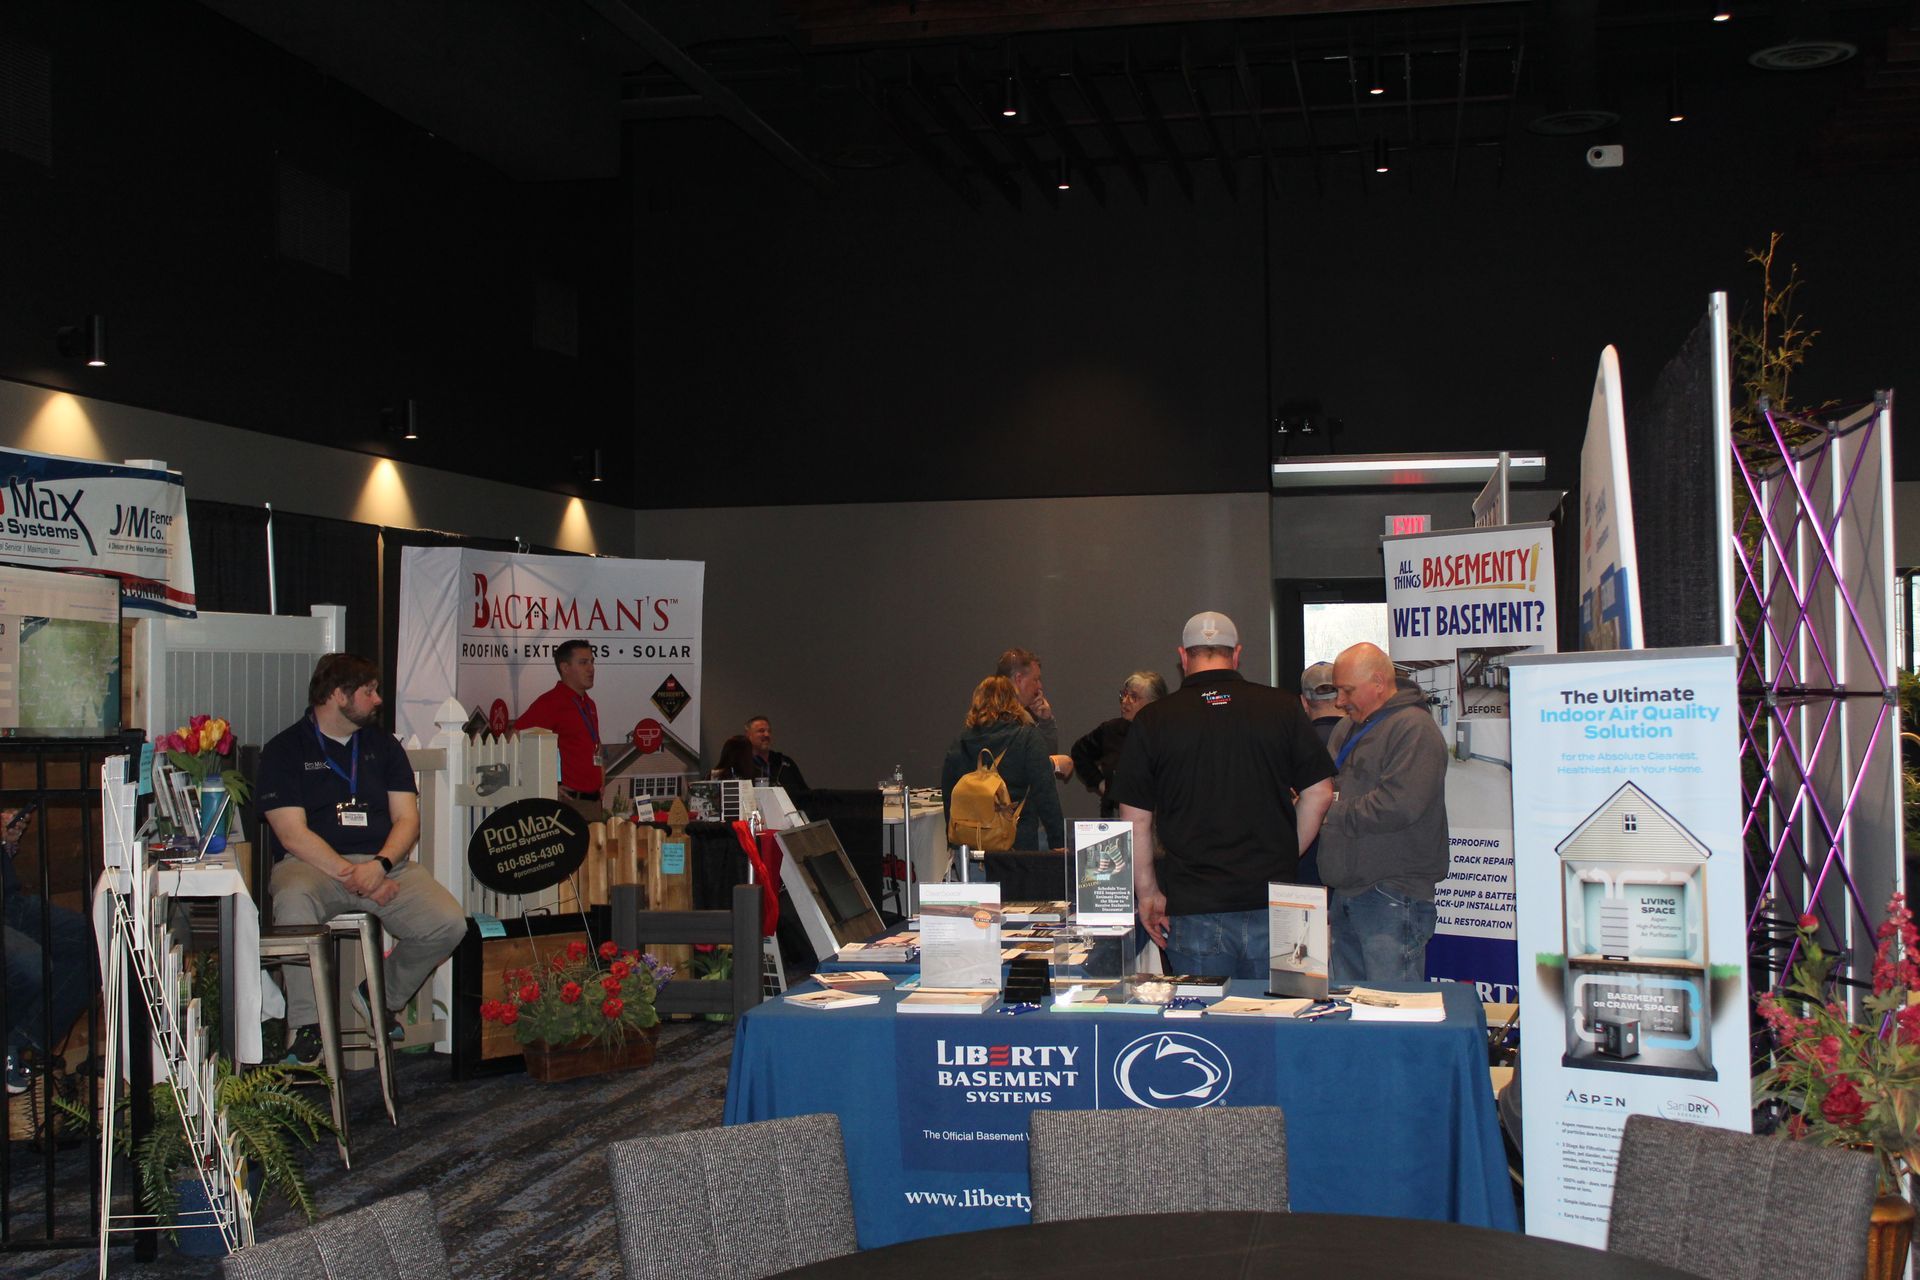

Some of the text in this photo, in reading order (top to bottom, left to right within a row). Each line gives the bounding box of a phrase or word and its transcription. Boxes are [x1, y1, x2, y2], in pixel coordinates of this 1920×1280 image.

[9, 476, 98, 556] Max
[109, 503, 149, 539] J/M
[150, 510, 173, 526] Fence
[7, 518, 79, 540] Systems
[150, 526, 164, 540] Co.
[1393, 516, 1425, 535] EXIT
[1399, 560, 1413, 574] ALL
[1422, 541, 1540, 593] BASEMENTY!
[1394, 574, 1421, 590] THINGS
[1393, 600, 1545, 637] WET BASEMENT?
[462, 644, 691, 659] ROOFING EXTERS SOLAR
[1560, 687, 1694, 704] The Ultimate
[1467, 705, 1502, 714] BEFORE
[1540, 704, 1720, 723] Indoor Air Quality
[1584, 723, 1673, 740] Solution
[1562, 752, 1577, 761] for
[1578, 753, 1596, 761] the
[1598, 752, 1645, 761] Absolute
[1557, 766, 1611, 774] Healthiest
[1613, 766, 1627, 774] Air
[1629, 766, 1639, 774] in
[1641, 766, 1666, 774] Your
[483, 808, 576, 849] Pro Max
[488, 828, 561, 856] Fence Systems
[1448, 838, 1500, 848] ERPROOFING
[497, 843, 565, 874] 610-685-4300
[1453, 855, 1481, 864] CRACK
[1482, 857, 1514, 866] REPAIR
[513, 861, 555, 879] #promaxfence
[1446, 872, 1508, 883] UMIDIFICATION
[1434, 888, 1517, 901] UMP PUMP & BATTER
[1641, 898, 1676, 906] LIVING
[1435, 899, 1517, 913] ACK-UP INSTALLATI
[1454, 917, 1513, 929] RESTORATION
[1607, 992, 1664, 1003] BASEMENT
[1606, 1001, 1642, 1011] CRAWL
[1643, 1003, 1680, 1013] SPACE
[937, 1040, 1079, 1067] LIBERTY
[937, 1071, 1079, 1087] BASEMENT
[966, 1091, 1052, 1103] SYSTEMS
[1566, 1089, 1626, 1107] ASPEN
[1666, 1100, 1710, 1114] SaniDRY
[923, 1130, 941, 1140] The
[942, 1130, 974, 1141] Official
[976, 1131, 1025, 1142] Basement
[904, 1188, 1032, 1213] www.liberty
